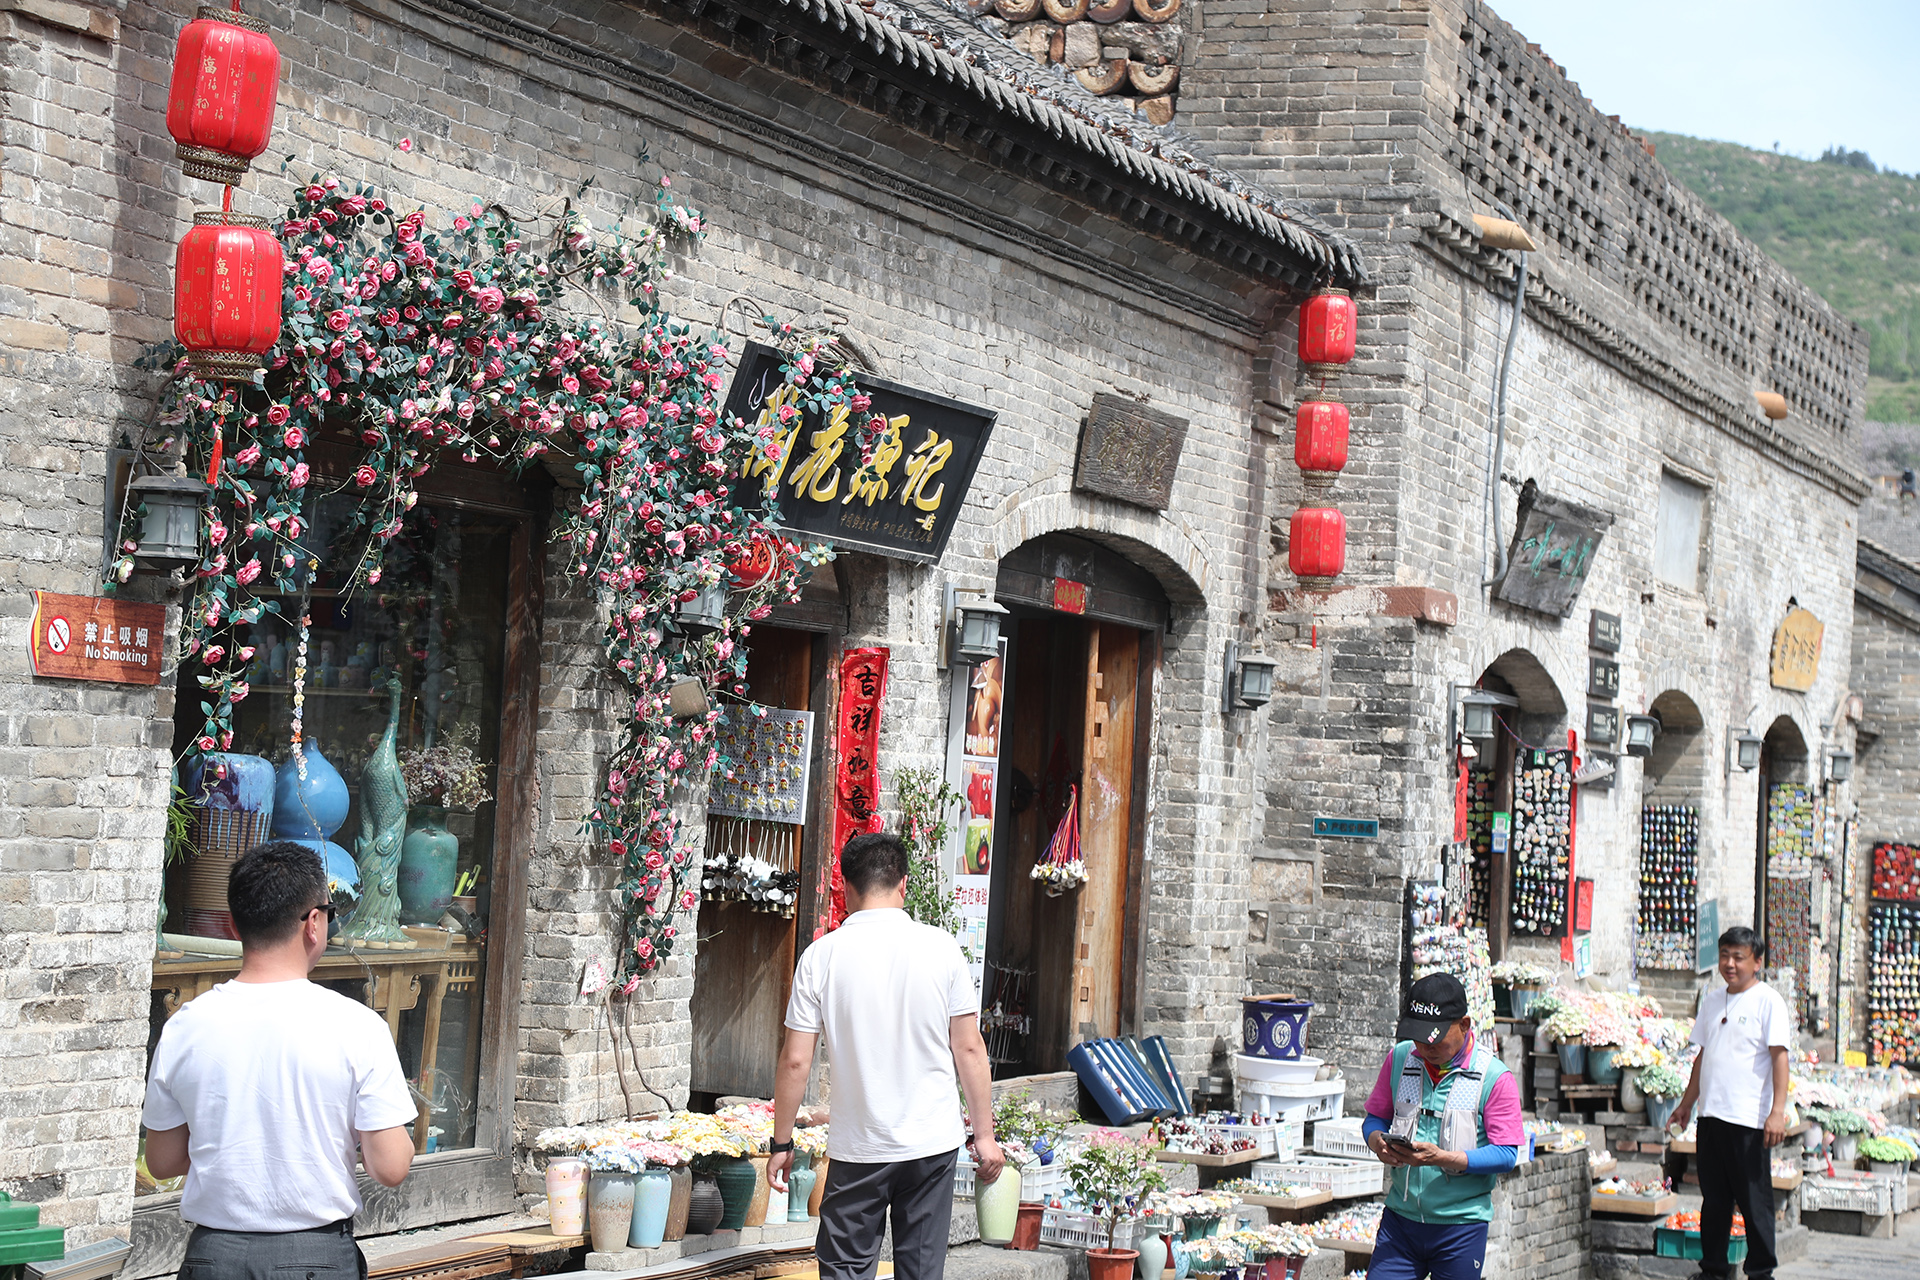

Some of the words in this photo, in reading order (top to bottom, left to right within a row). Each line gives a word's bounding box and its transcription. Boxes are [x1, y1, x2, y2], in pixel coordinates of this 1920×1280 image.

[914, 512, 936, 532] 一店
[85, 621, 149, 647] 禁止吸烟
[85, 645, 101, 659] No
[102, 646, 148, 666] Smoking
[844, 665, 880, 845] 吉祥如意
